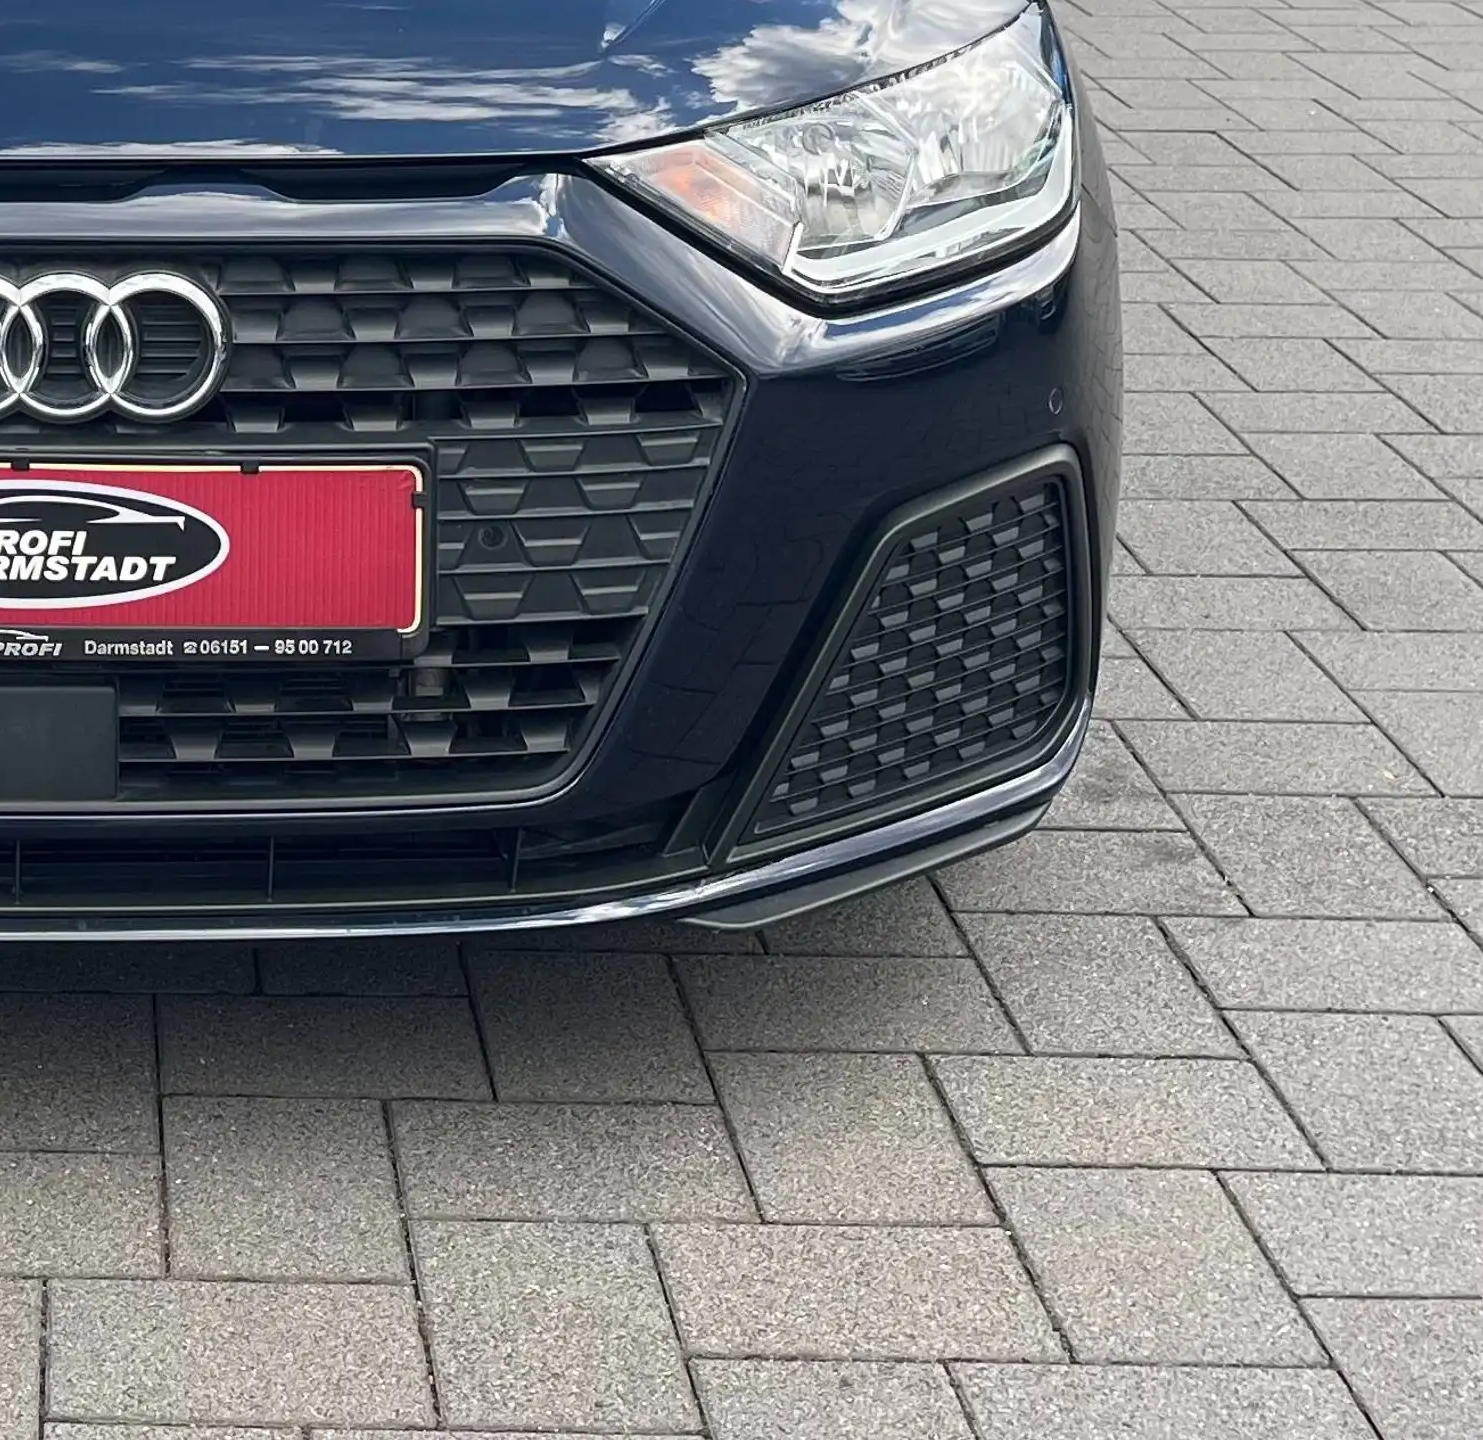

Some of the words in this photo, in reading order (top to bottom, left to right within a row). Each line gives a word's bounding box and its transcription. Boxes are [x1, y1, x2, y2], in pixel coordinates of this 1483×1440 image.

[84, 639, 174, 656] Darmstadt
[199, 639, 248, 655] 06151
[322, 639, 353, 656] 712
